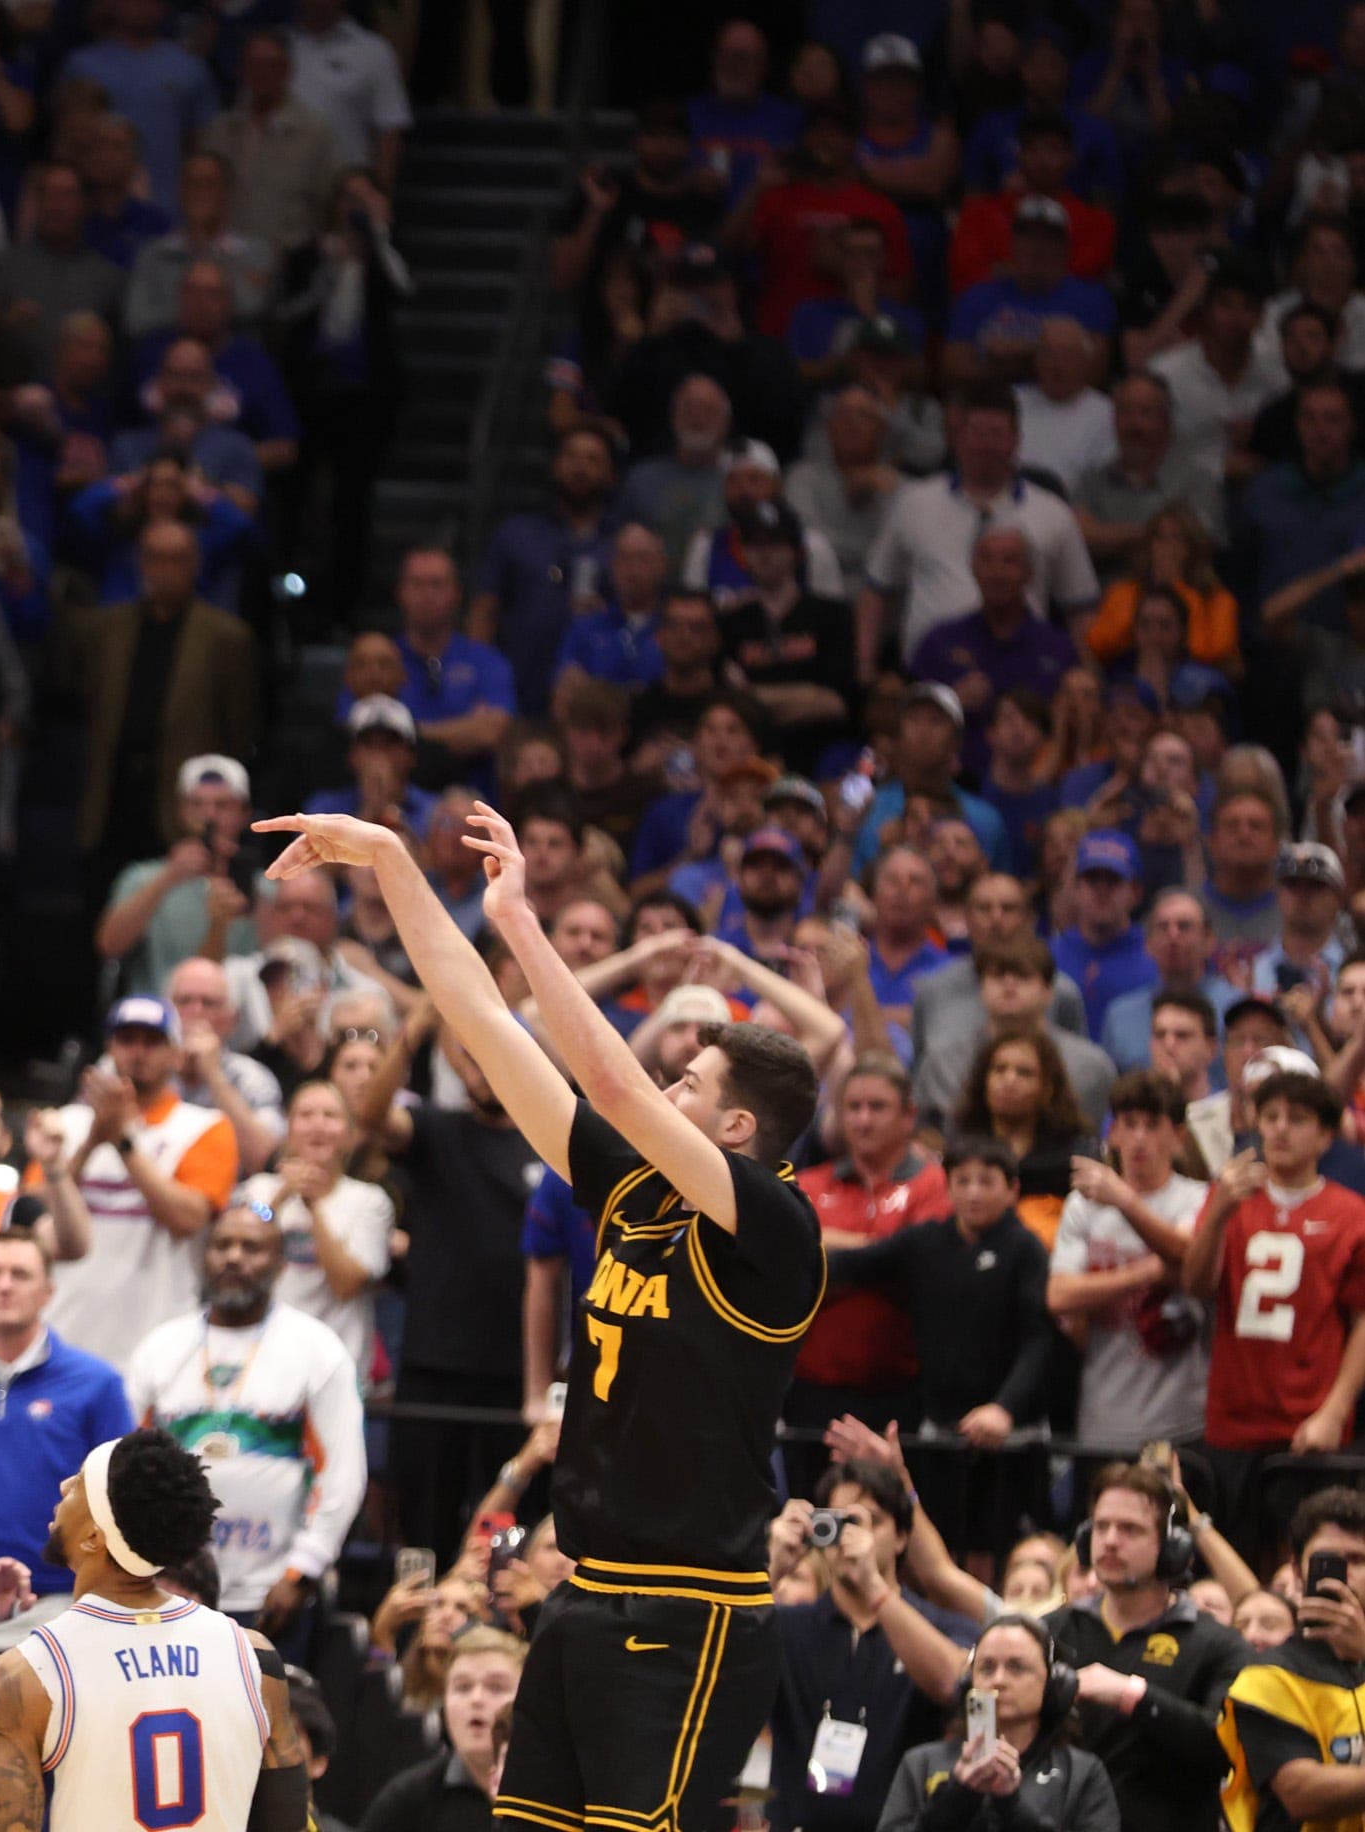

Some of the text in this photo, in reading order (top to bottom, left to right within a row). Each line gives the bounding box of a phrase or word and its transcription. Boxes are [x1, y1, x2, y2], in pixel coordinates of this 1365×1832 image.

[1236, 1230, 1305, 1342] 2
[587, 1313, 623, 1402] 7
[114, 1644, 199, 1682] FLAND
[129, 1708, 206, 1832] 0
